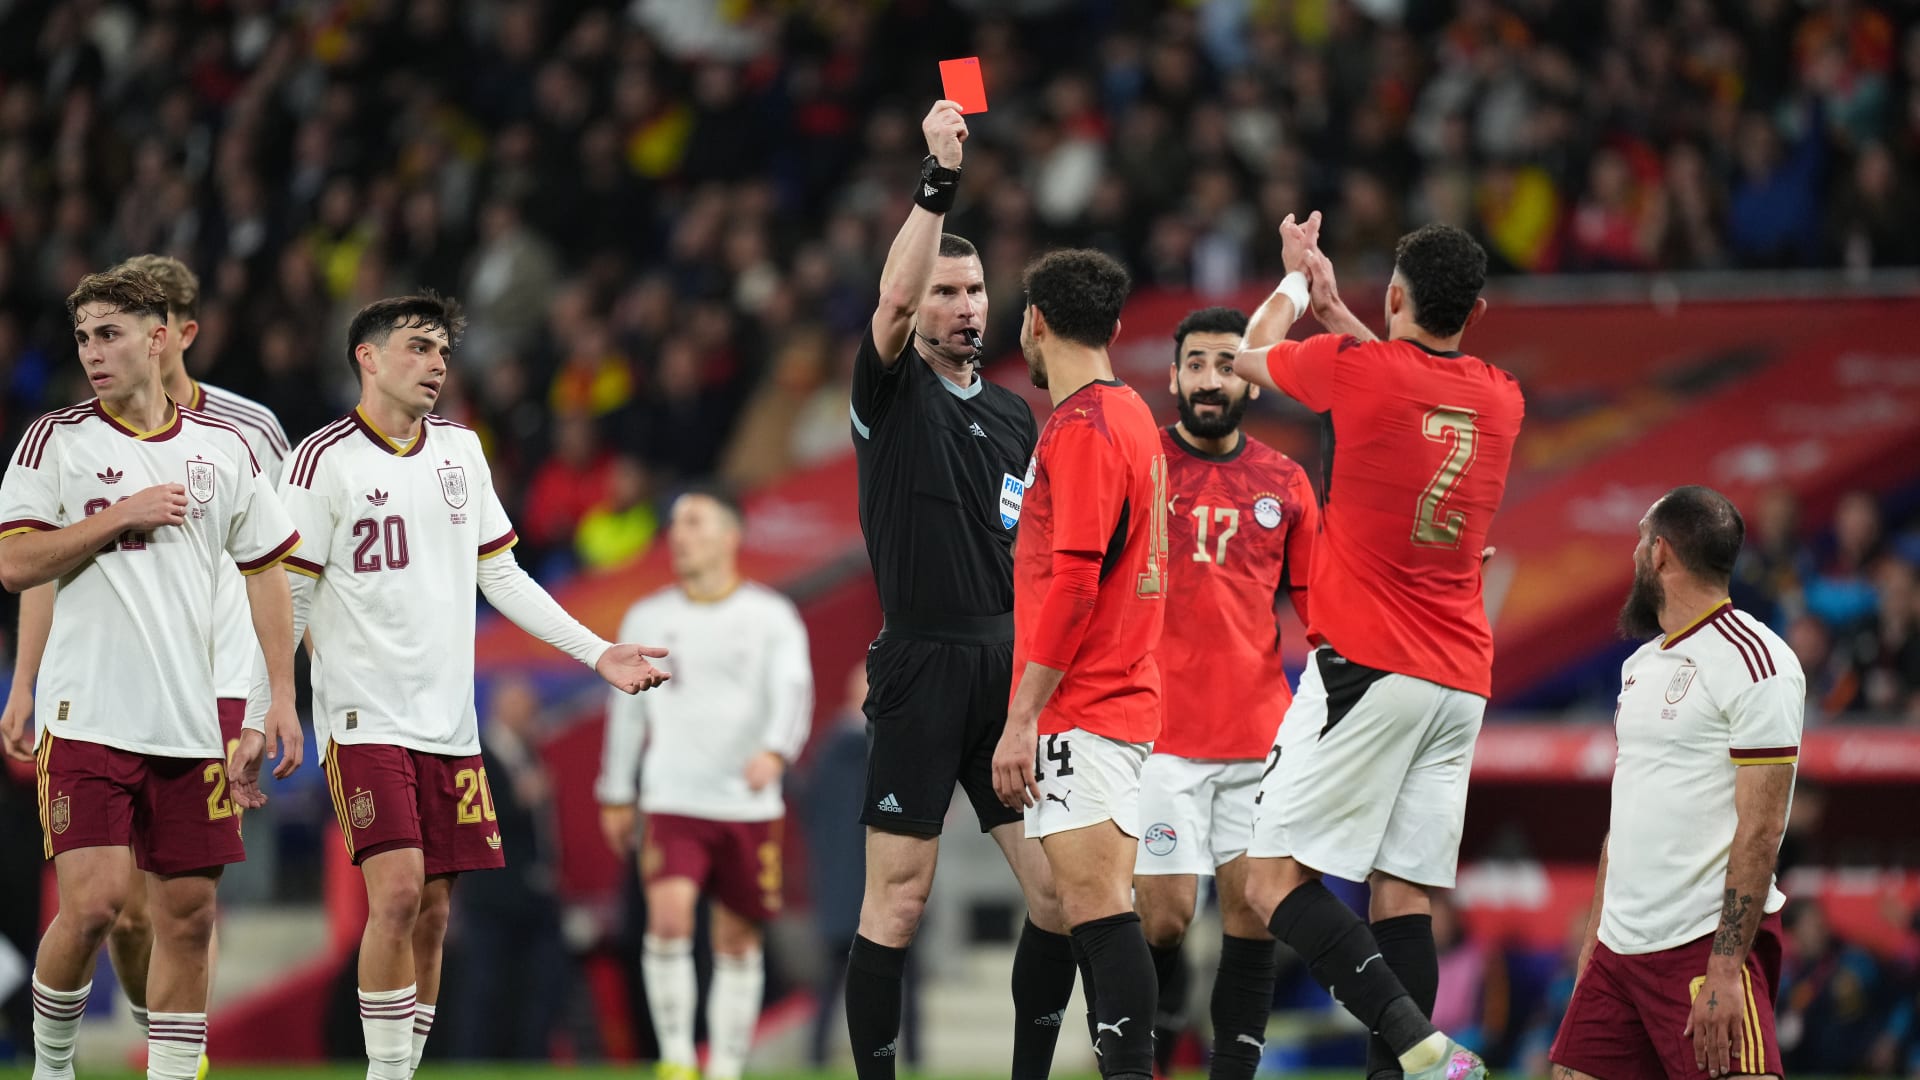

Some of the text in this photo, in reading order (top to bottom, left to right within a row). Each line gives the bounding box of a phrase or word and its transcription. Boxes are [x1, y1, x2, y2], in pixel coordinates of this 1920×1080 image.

[1002, 497, 1020, 511] REFEREE
[1005, 477, 1023, 496] FIFA
[1410, 404, 1479, 550] 2
[352, 514, 410, 573] 20
[1192, 505, 1240, 566] 17
[203, 762, 236, 821] 2
